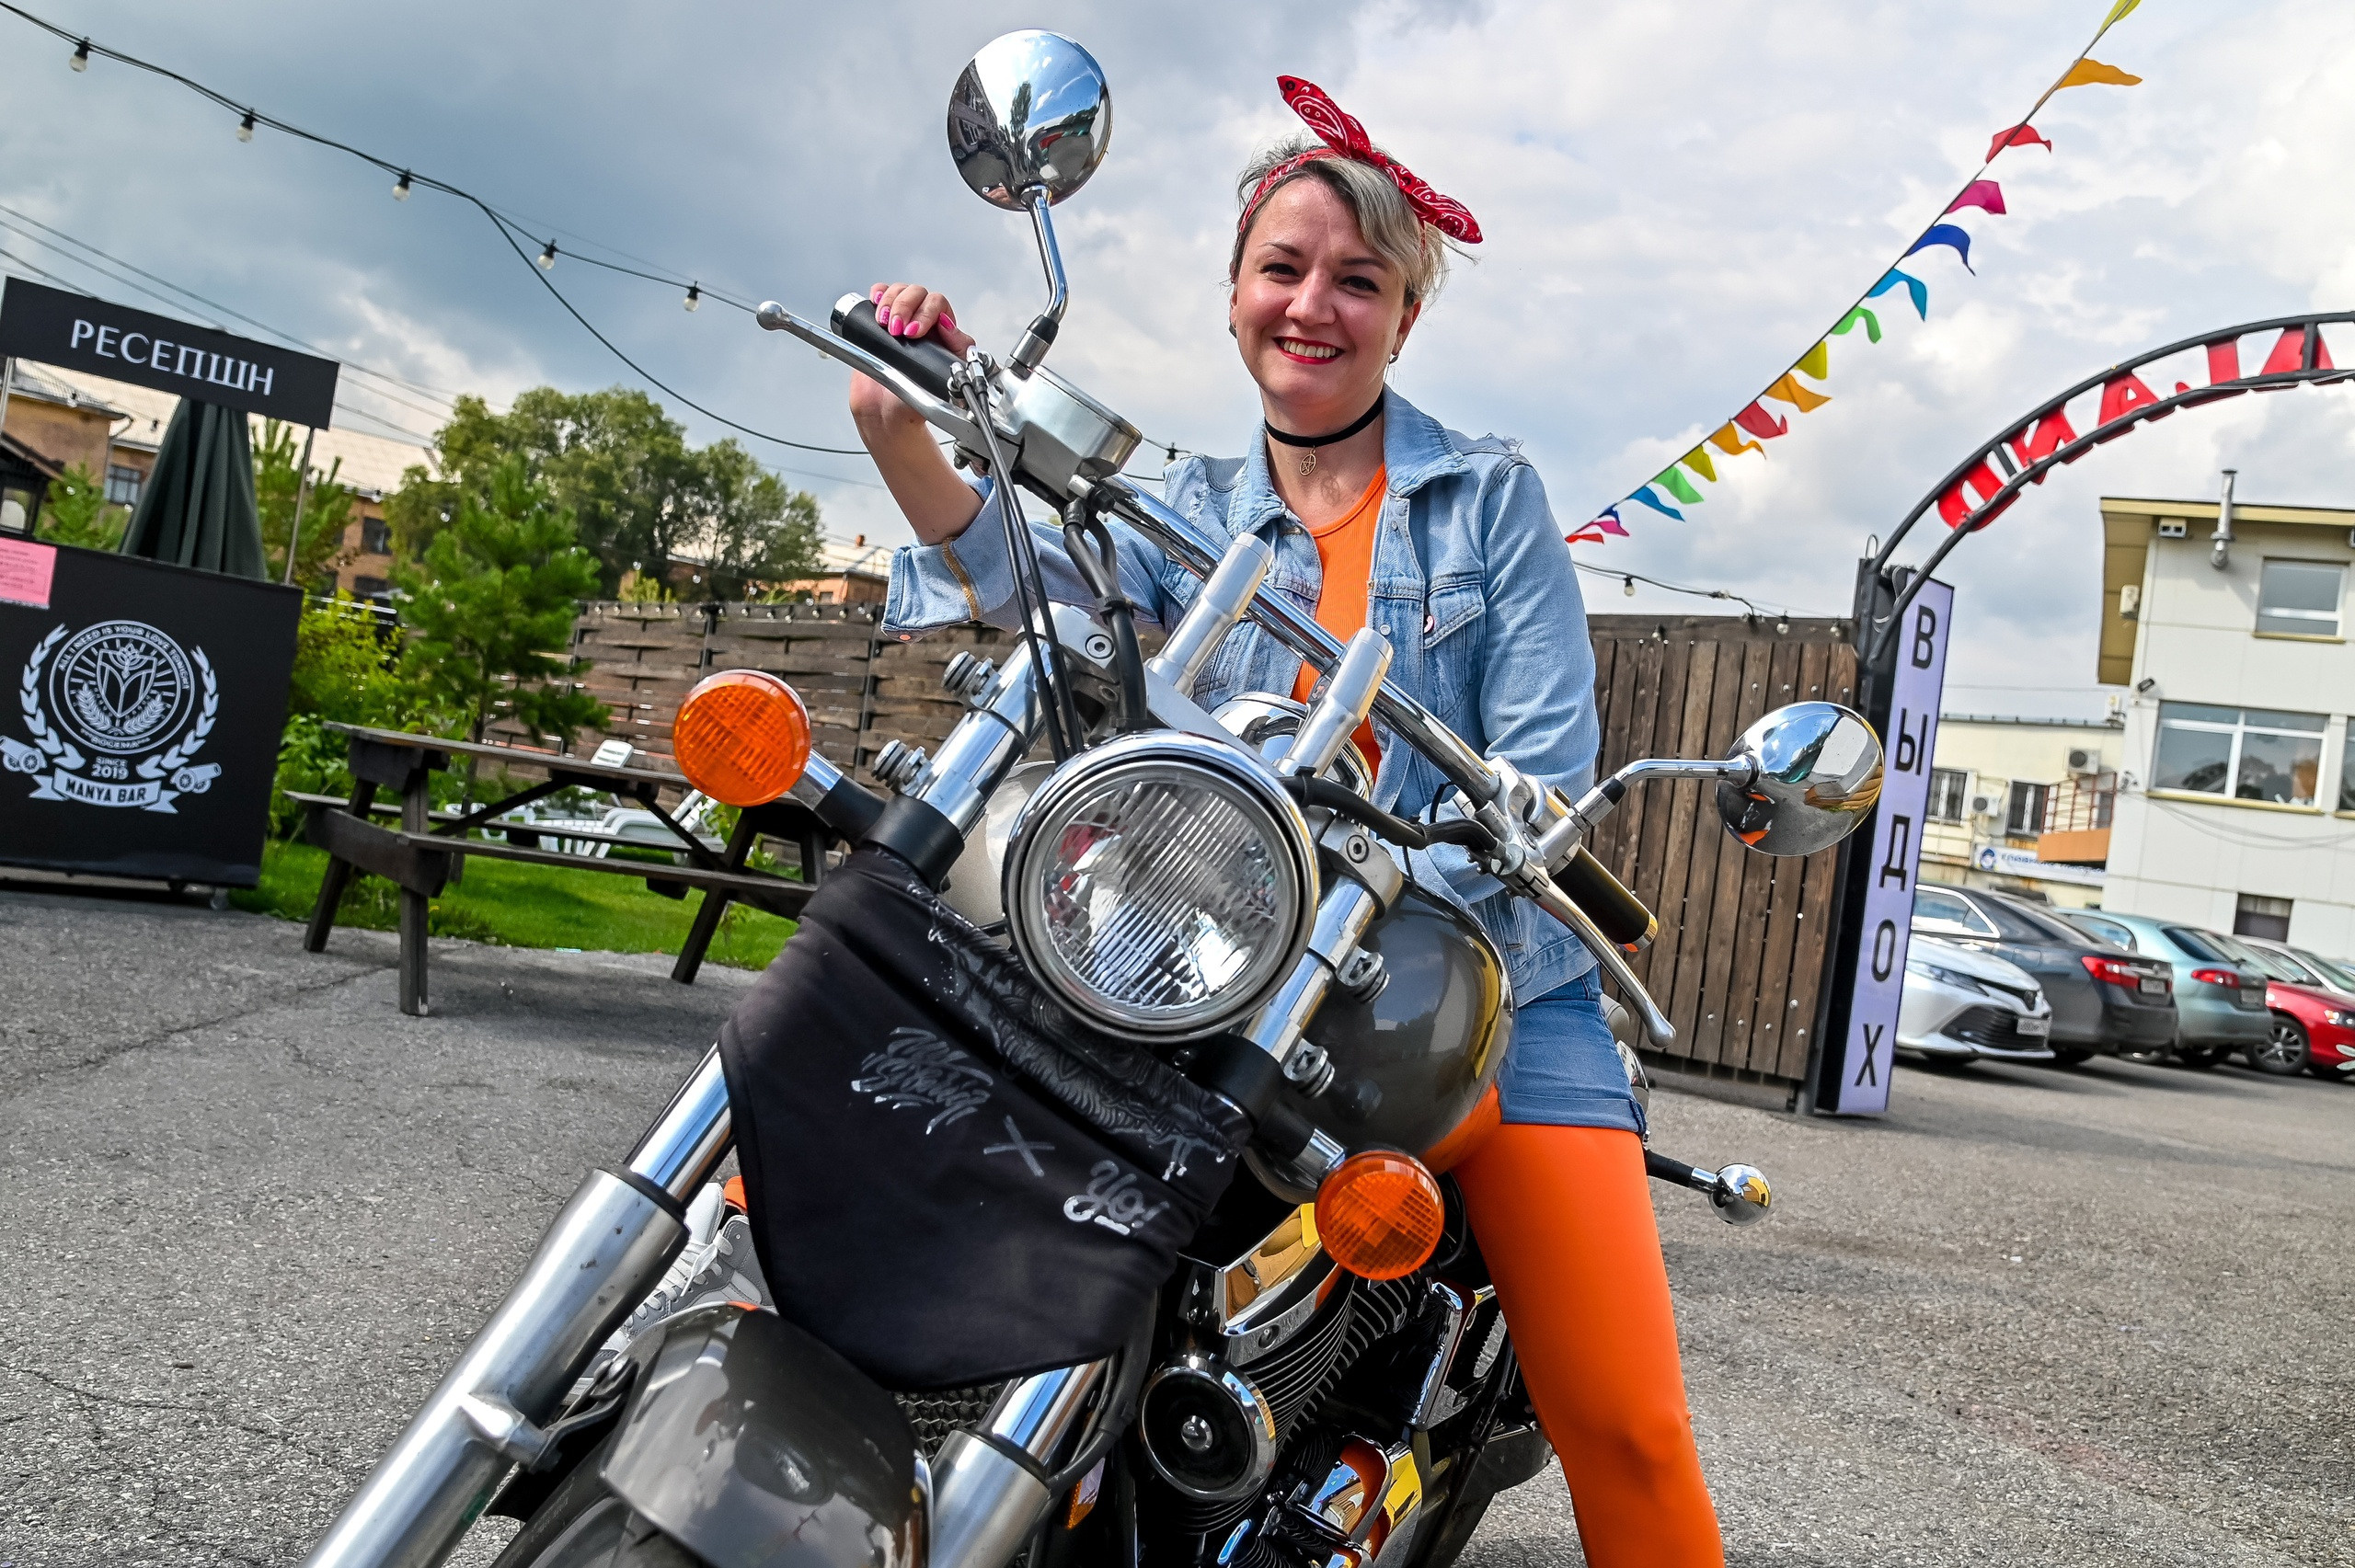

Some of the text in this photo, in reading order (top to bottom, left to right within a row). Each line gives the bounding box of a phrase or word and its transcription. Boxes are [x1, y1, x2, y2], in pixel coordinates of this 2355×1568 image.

[70, 318, 274, 396] РЕСЕПШН
[74, 629, 101, 650] NEED
[101, 625, 113, 635] IS
[114, 624, 145, 636] YOUR
[145, 631, 170, 650] LOVE
[91, 763, 129, 780] 2019
[96, 756, 128, 767] SINCE
[65, 777, 146, 803] MANYA BAR
[1854, 603, 1937, 1088] ВЫДОХ
